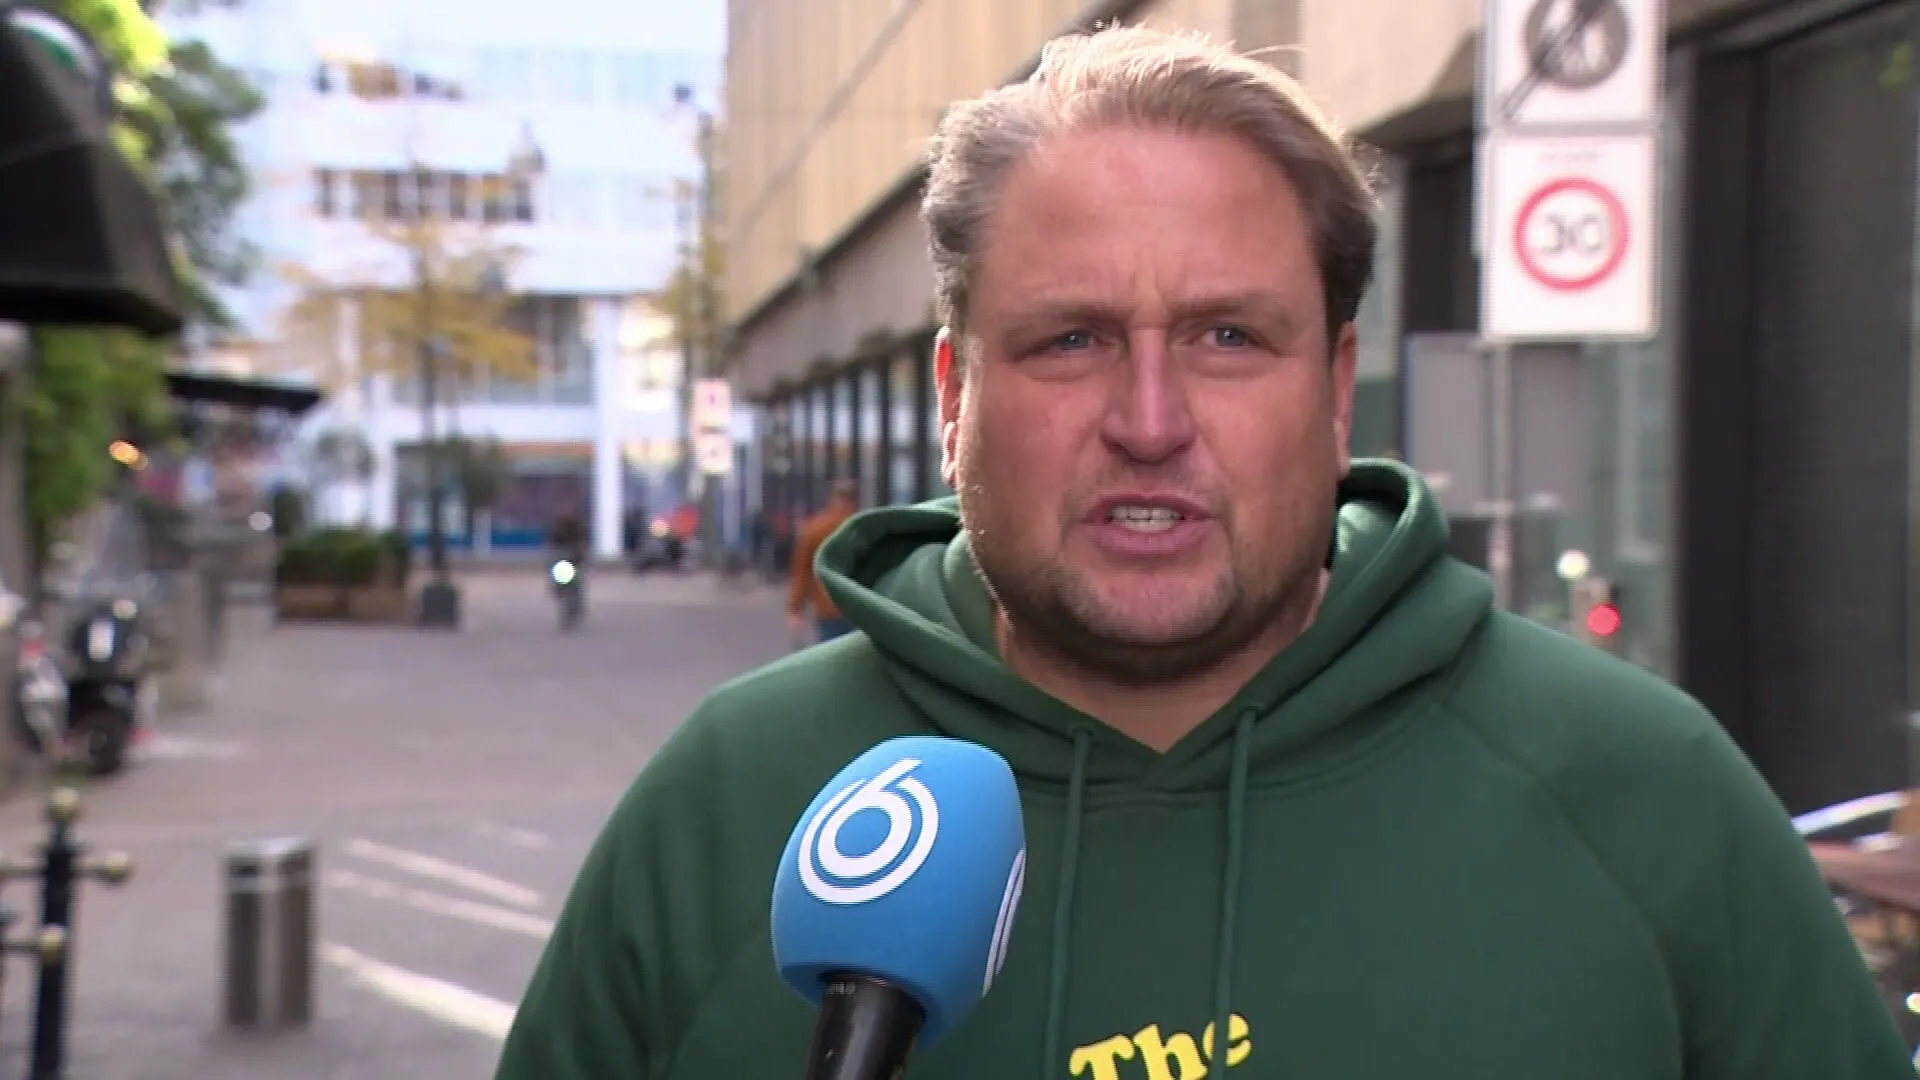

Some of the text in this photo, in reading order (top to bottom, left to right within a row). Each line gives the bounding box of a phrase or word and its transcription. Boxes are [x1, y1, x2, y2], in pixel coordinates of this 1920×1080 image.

[1541, 213, 1610, 256] 30
[817, 758, 923, 879] 6
[1069, 1013, 1252, 1080] The
